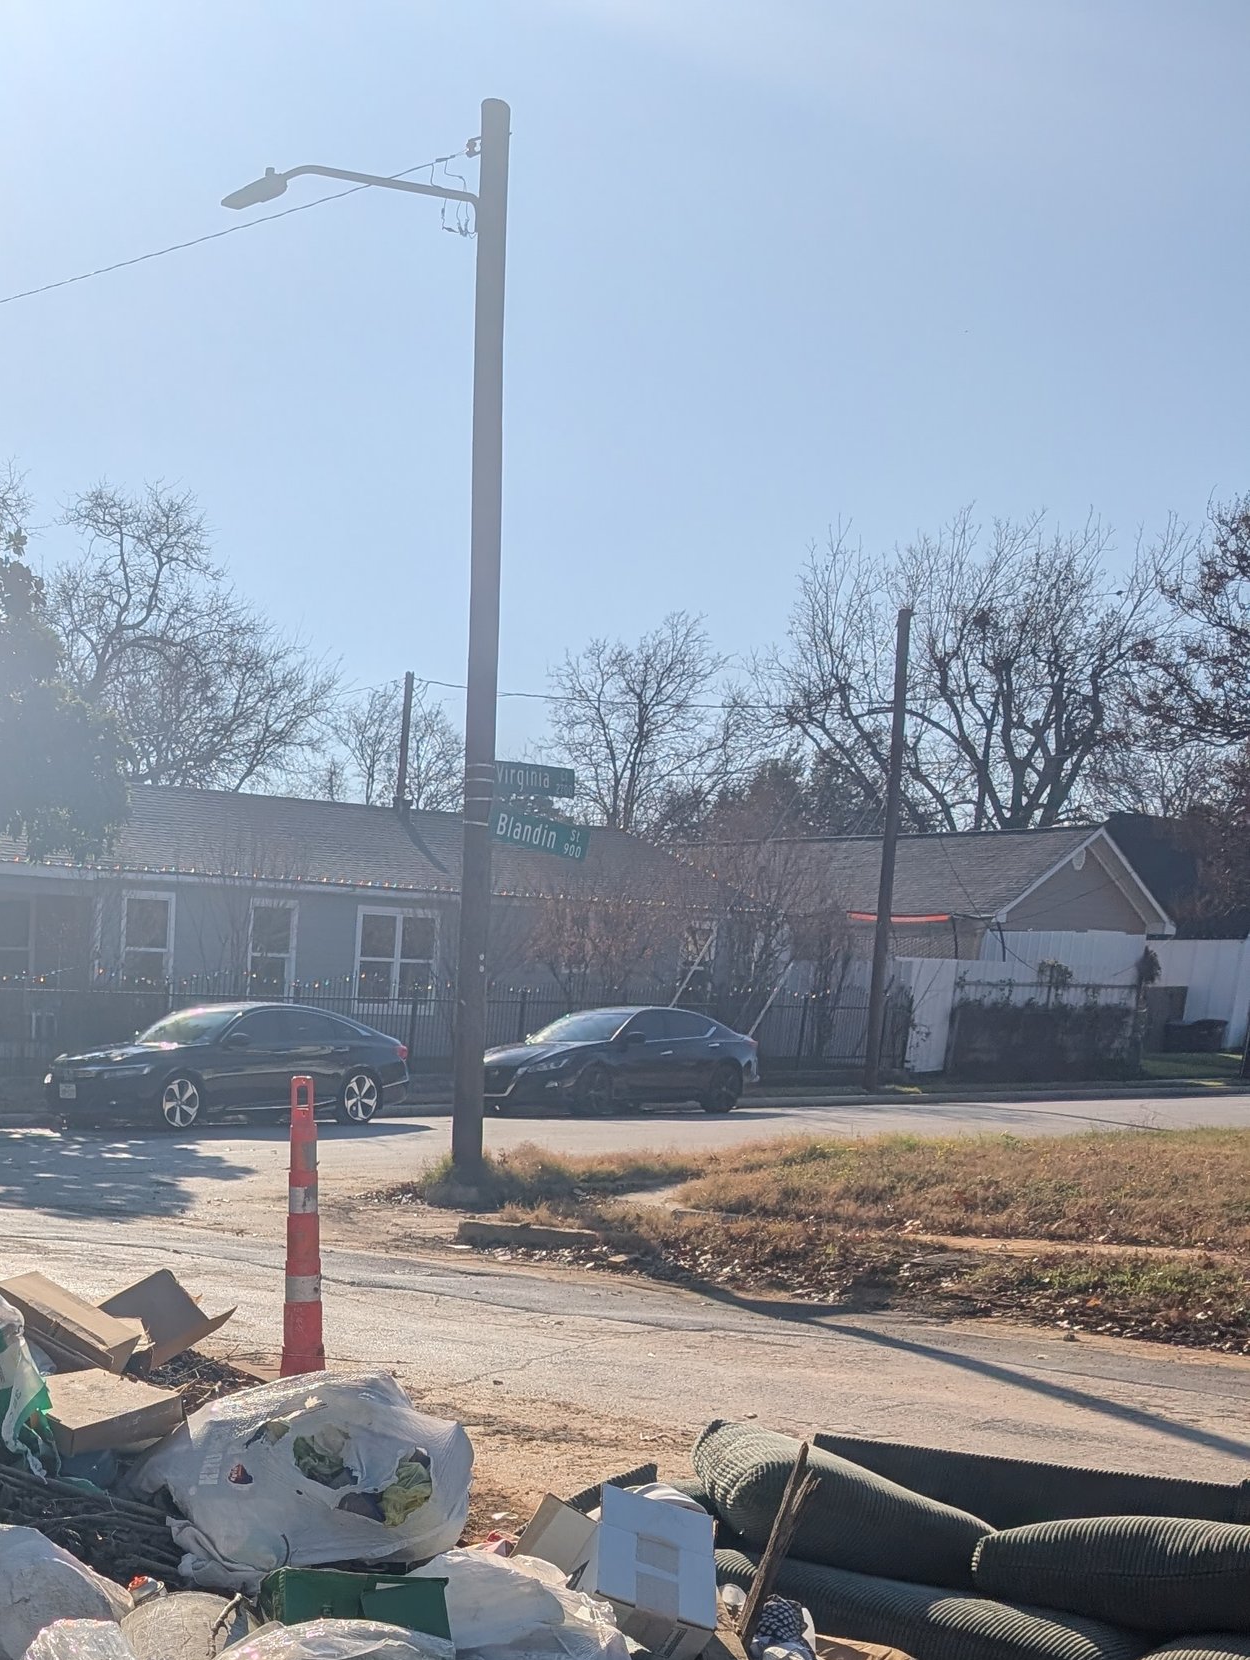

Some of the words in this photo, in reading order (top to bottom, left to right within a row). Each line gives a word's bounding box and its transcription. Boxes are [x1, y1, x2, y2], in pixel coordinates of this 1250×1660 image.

[496, 763, 550, 792] Virginia
[496, 813, 557, 849] Blandin
[570, 829, 581, 843] St
[563, 843, 582, 858] 900
